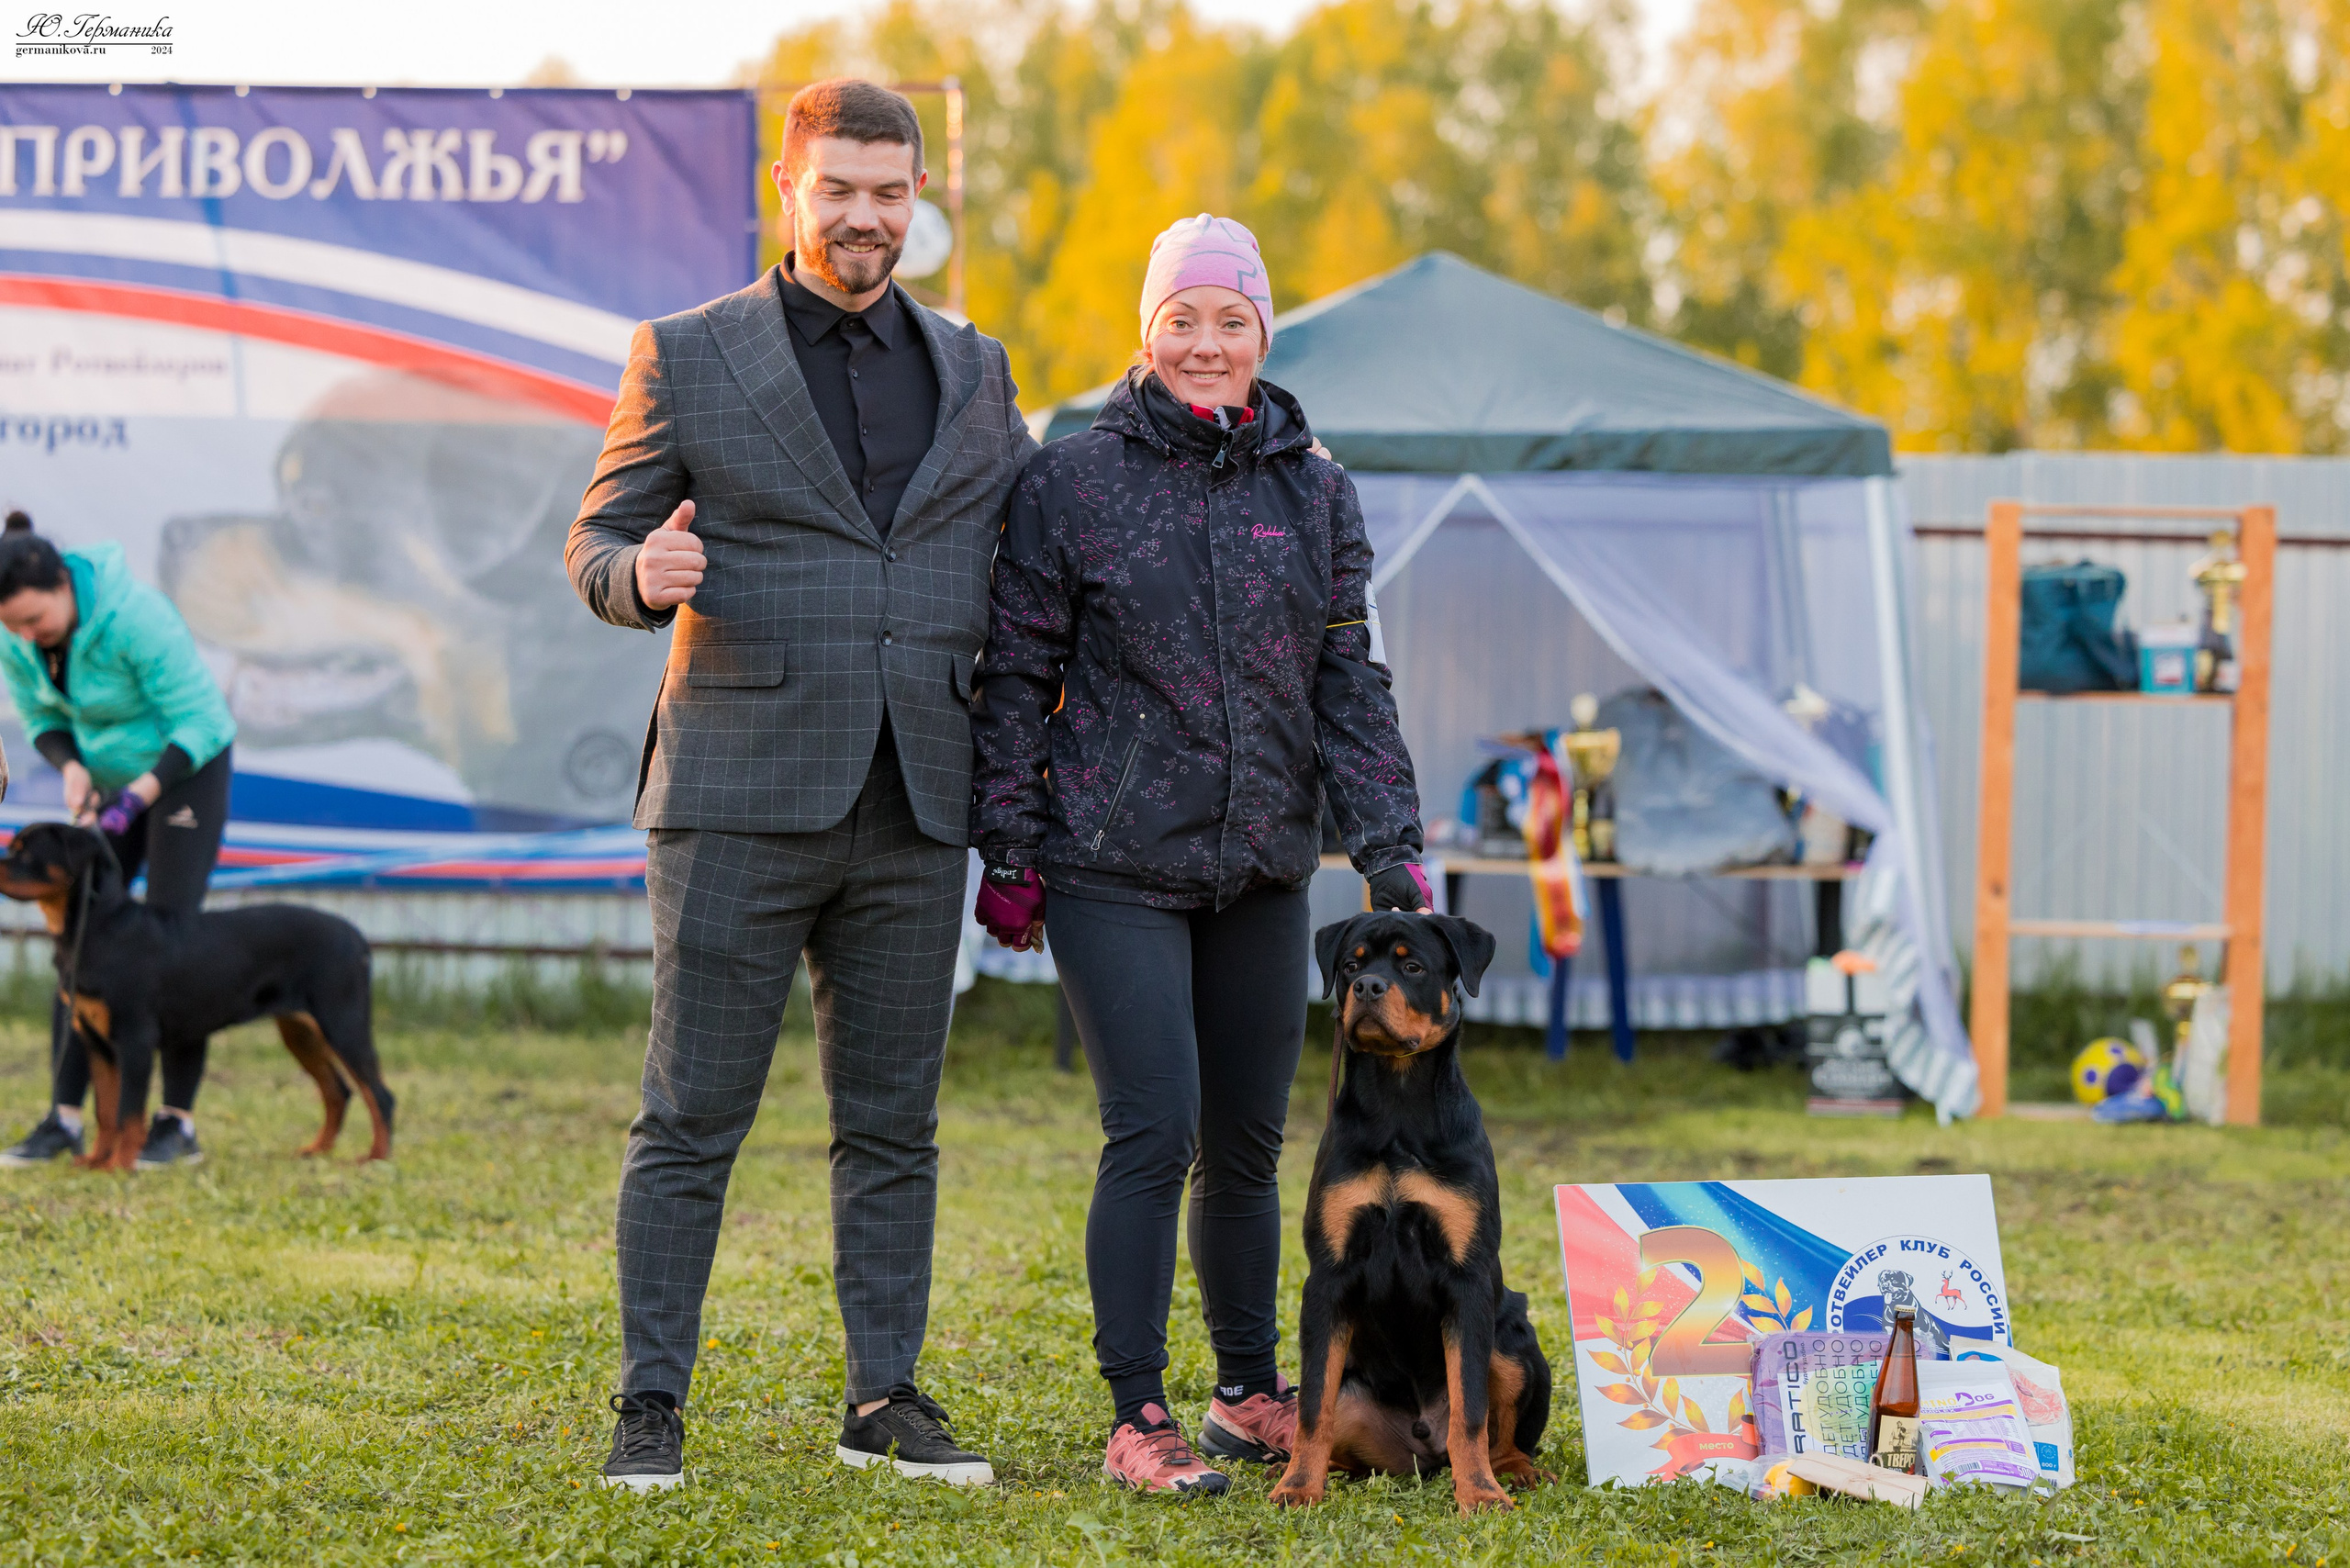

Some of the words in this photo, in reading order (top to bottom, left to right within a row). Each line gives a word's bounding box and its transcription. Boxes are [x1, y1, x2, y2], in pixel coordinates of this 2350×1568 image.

[1250, 523, 1284, 540] Rukka
[1638, 1225, 1754, 1377] 2
[1830, 1243, 1888, 1334] ОТВЕЙЛЕР
[1899, 1239, 1952, 1260] КЛУБ
[1958, 1259, 2006, 1335] РОССИИ
[1812, 1339, 1832, 1419] УДОБНО
[1830, 1339, 1852, 1419] УДОБНО
[1850, 1339, 1870, 1419] УДОБНО
[1698, 1442, 1735, 1450] место
[1839, 1423, 1860, 1459] ДЕТ
